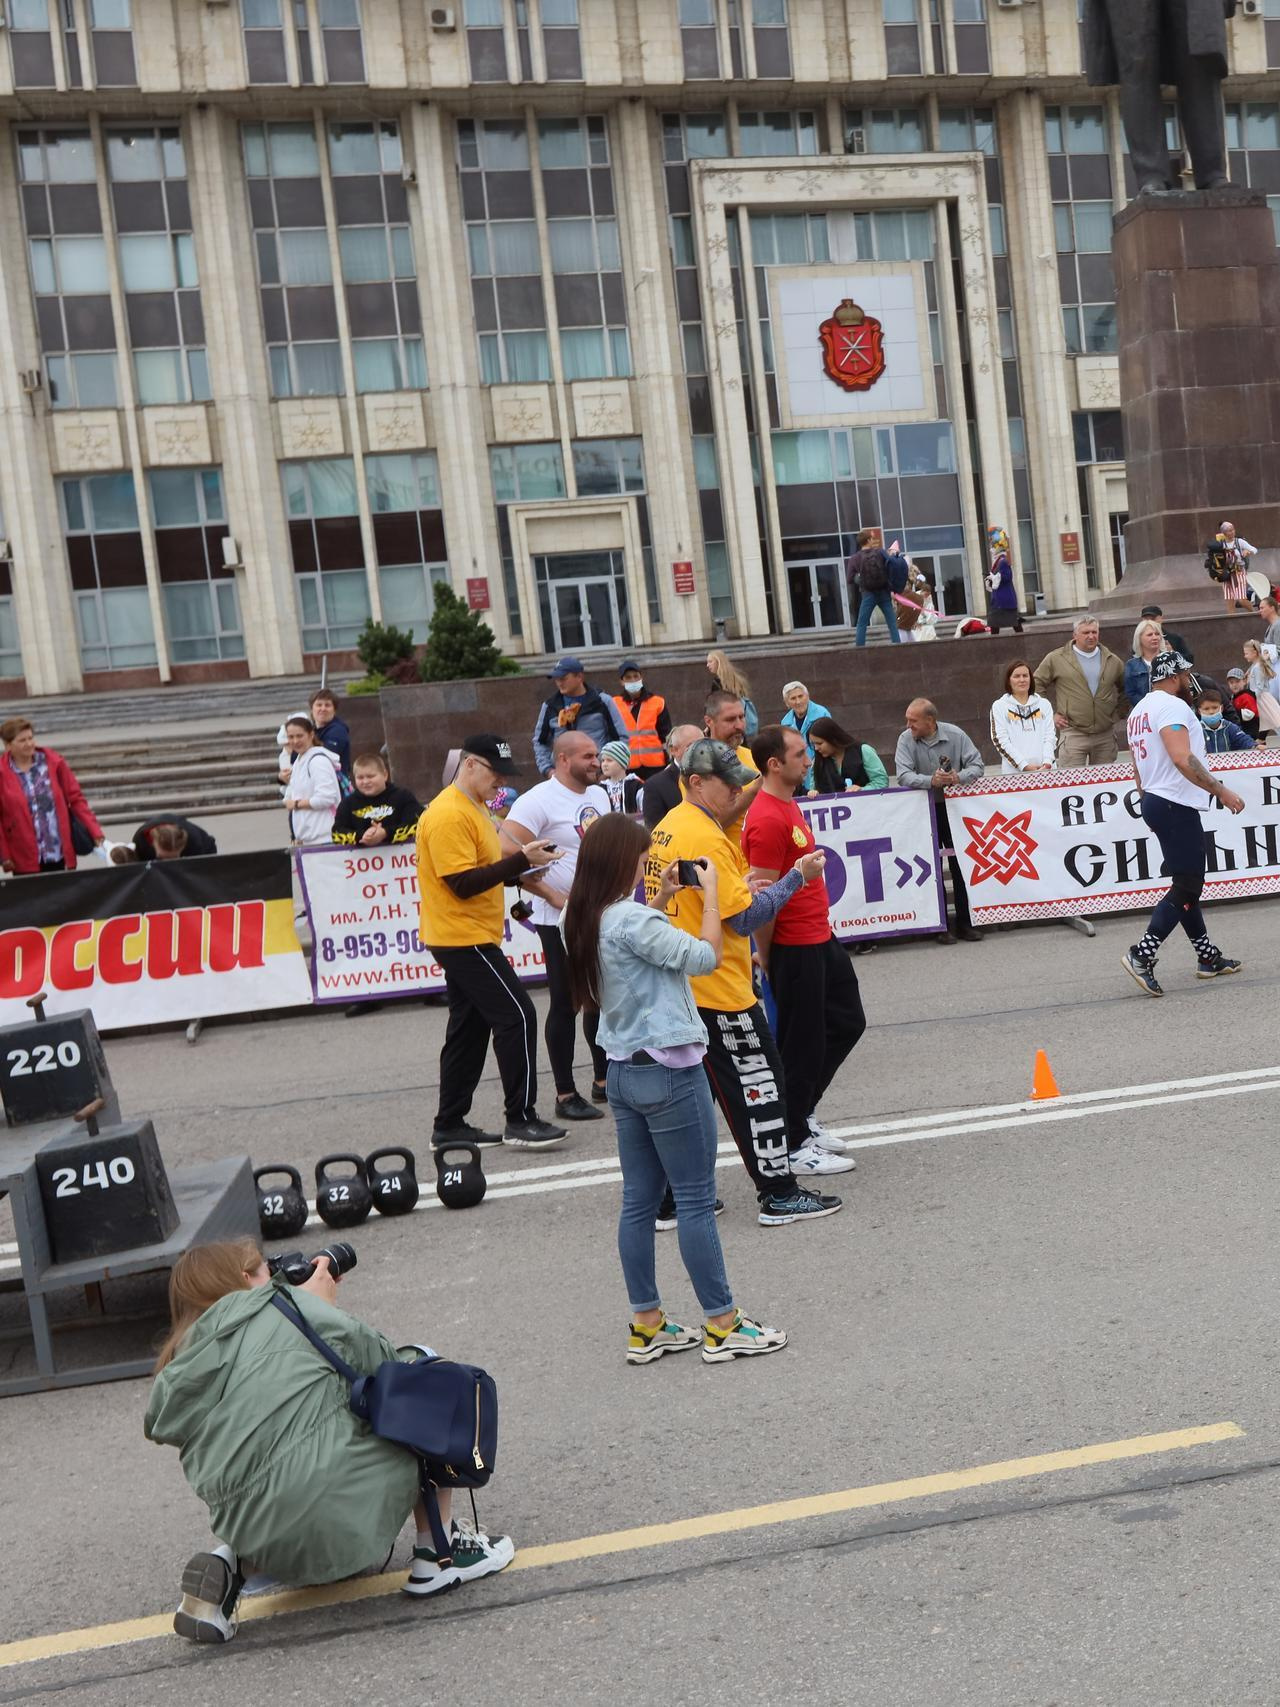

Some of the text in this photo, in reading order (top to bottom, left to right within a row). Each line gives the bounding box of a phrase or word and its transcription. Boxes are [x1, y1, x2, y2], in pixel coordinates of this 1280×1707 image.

[1127, 712, 1153, 738] УЛА
[344, 853, 418, 880] 300 ме
[362, 883, 389, 899] от
[330, 911, 363, 925] им.
[368, 903, 408, 921] Л.Н.
[841, 917, 869, 928] вход
[876, 910, 917, 924] торца)
[7, 1040, 81, 1077] 220
[52, 1156, 135, 1198] 240
[380, 1176, 401, 1194] 24
[444, 1169, 462, 1187] 24
[329, 1185, 350, 1201] 32
[263, 1195, 285, 1216] 32
